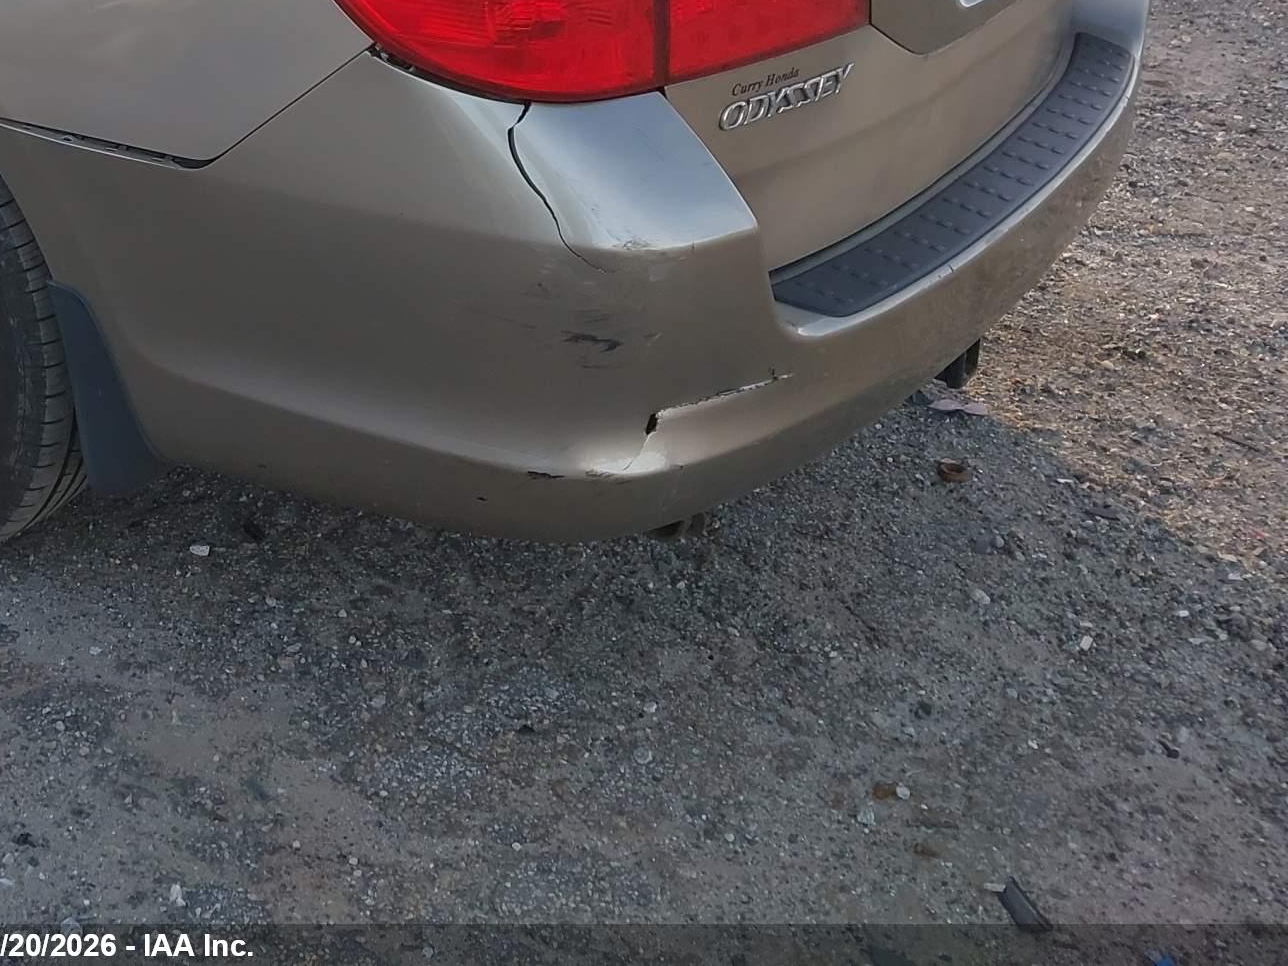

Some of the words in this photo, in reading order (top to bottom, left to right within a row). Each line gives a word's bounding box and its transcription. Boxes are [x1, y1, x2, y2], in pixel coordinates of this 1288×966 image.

[718, 62, 855, 132] ODYSSEY
[731, 80, 763, 98] Curry
[765, 67, 800, 89] Honda
